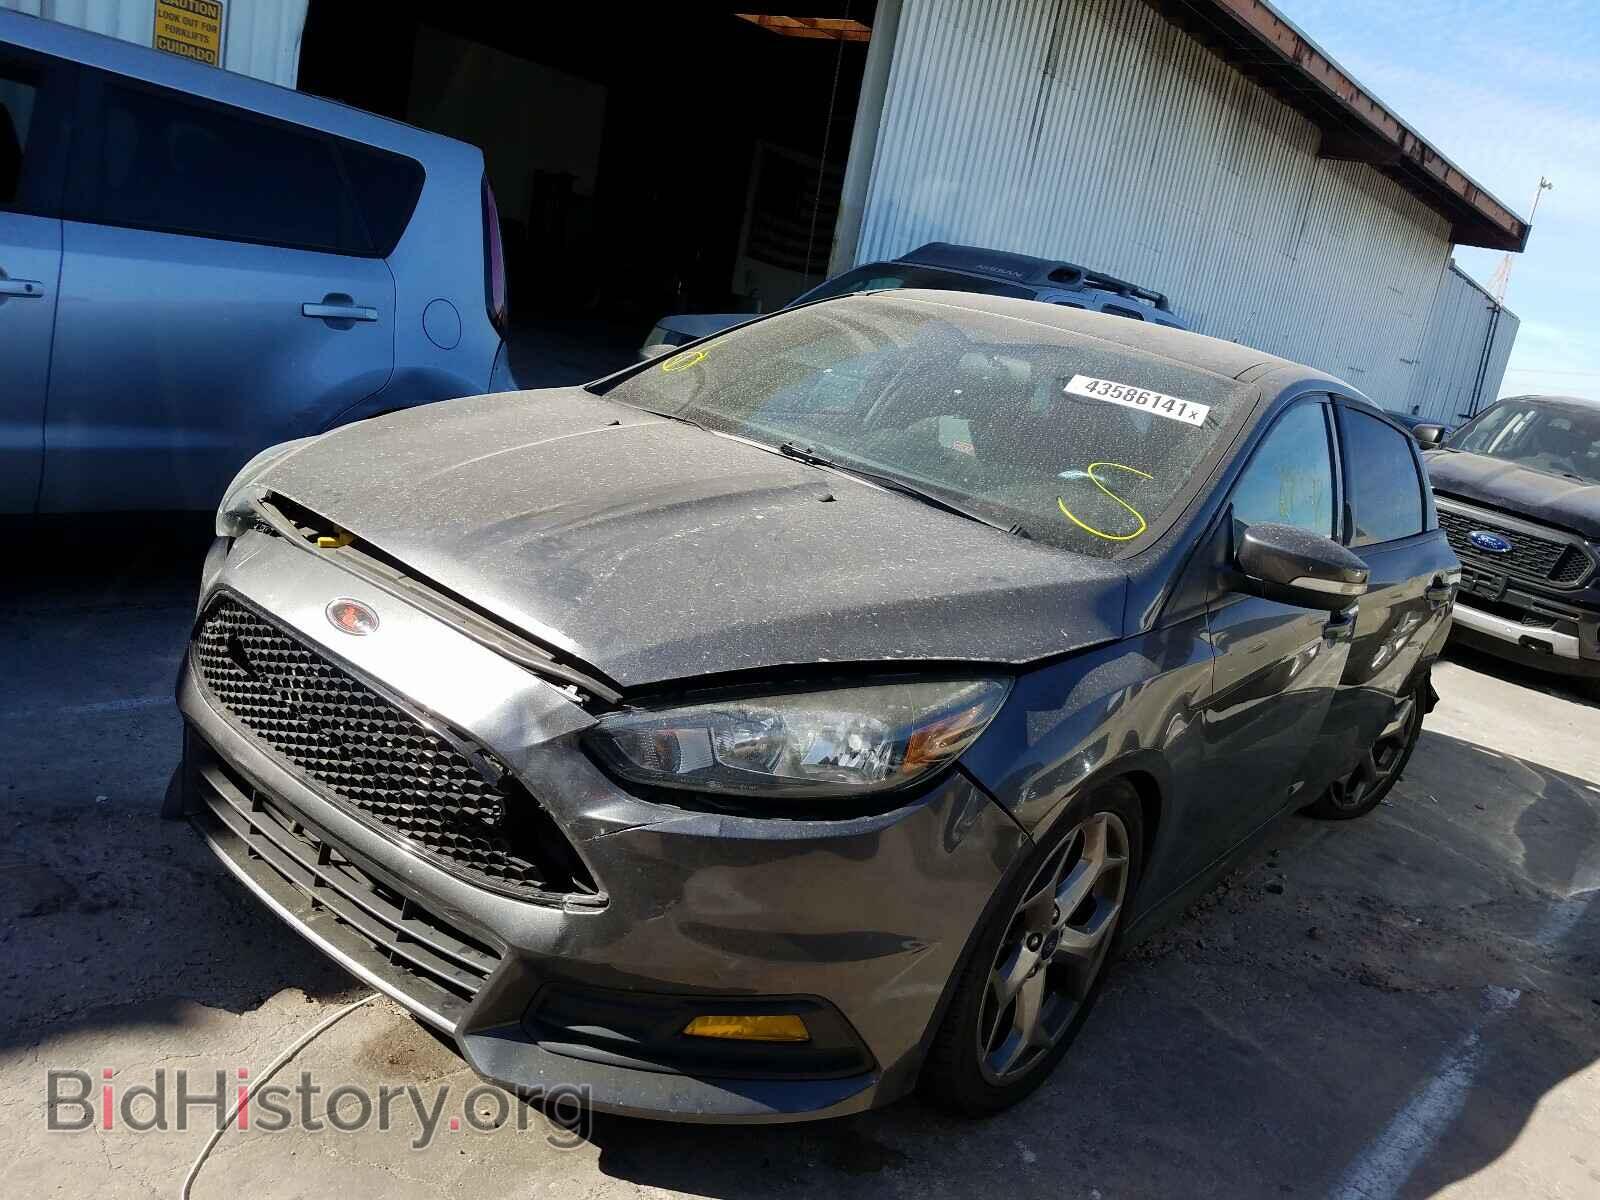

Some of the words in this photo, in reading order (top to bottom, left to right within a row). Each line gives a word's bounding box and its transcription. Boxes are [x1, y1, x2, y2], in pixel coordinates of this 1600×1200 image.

[159, 10, 181, 22] LOOK
[183, 16, 199, 28] OUT
[200, 22, 218, 32] FOR
[165, 23, 209, 43] FORKLIFTS
[158, 38, 214, 62] CUIDADO
[1057, 462, 1154, 541] S
